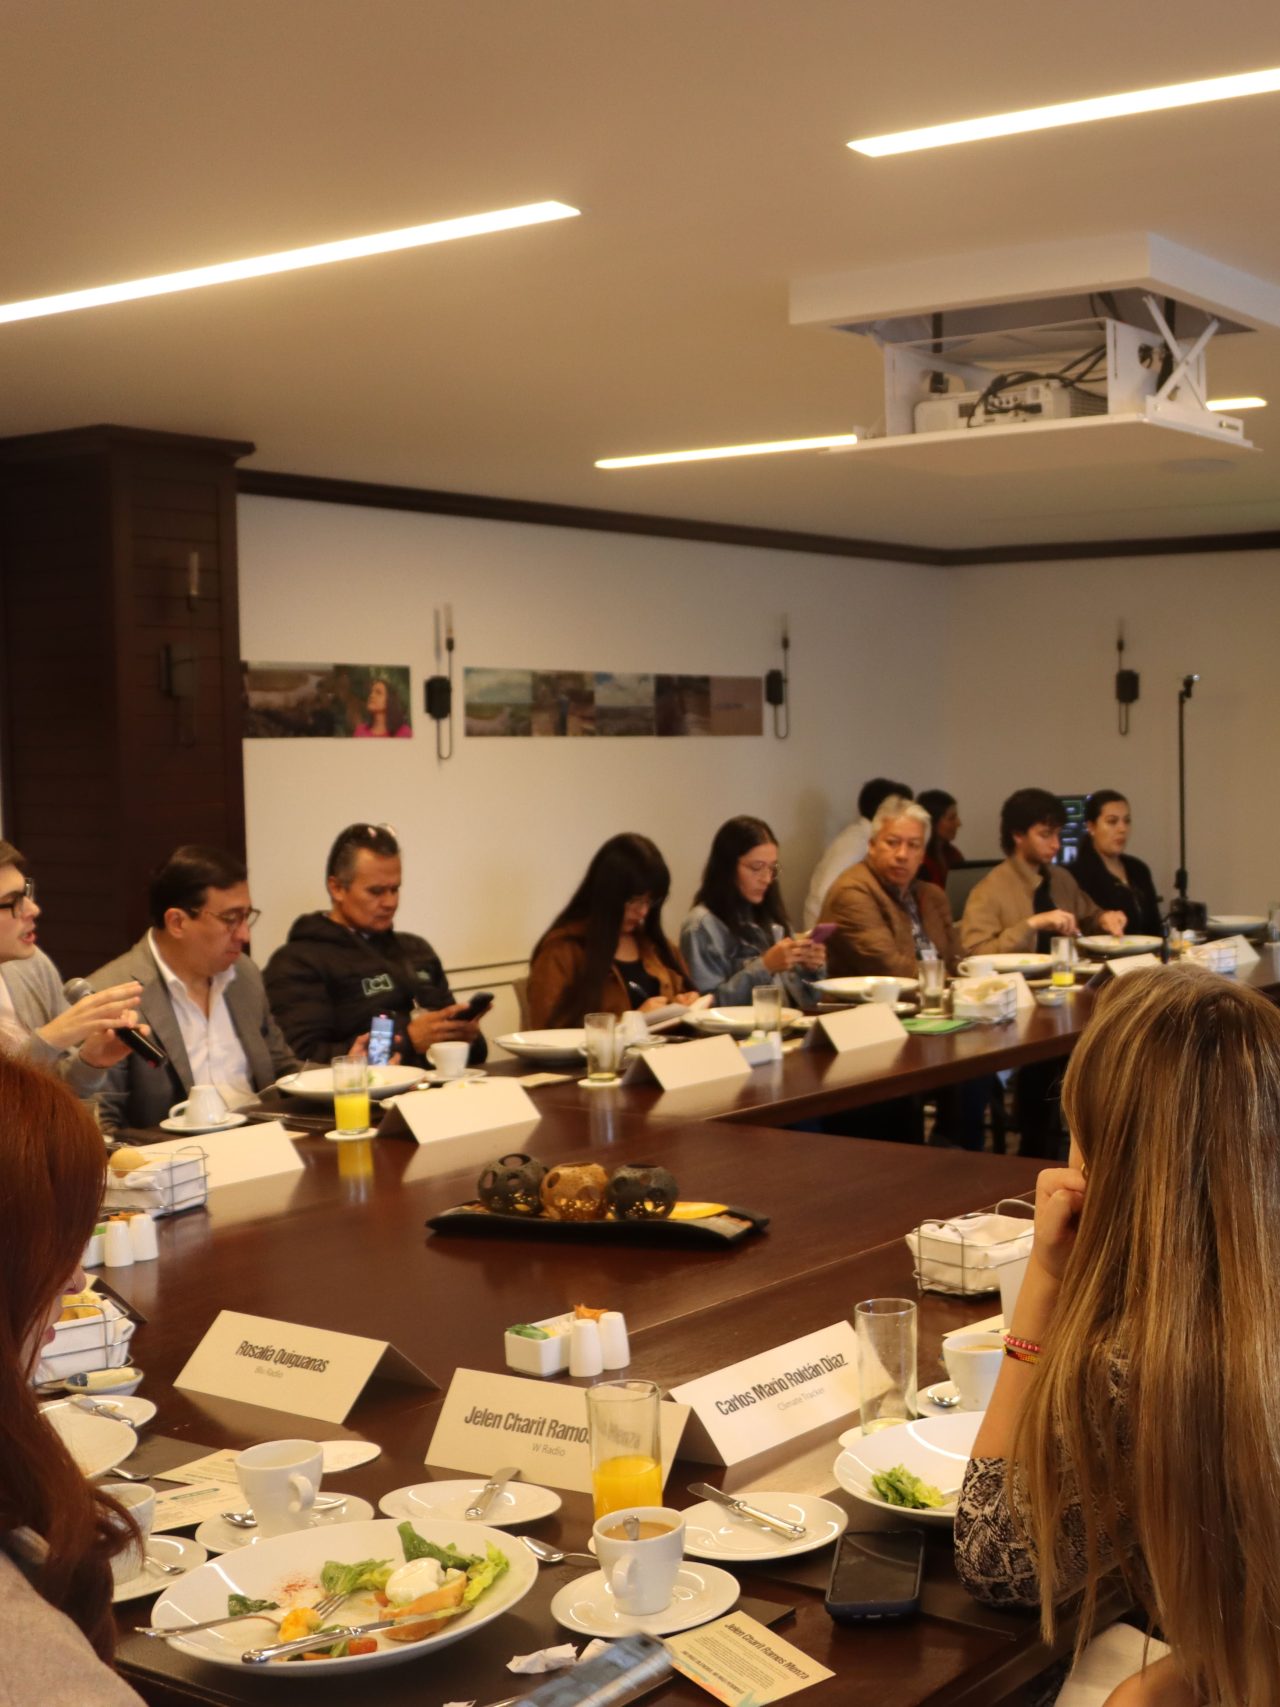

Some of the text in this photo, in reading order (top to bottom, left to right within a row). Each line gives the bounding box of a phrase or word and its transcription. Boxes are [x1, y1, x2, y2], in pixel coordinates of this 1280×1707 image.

[715, 1391, 757, 1416] Carlos
[751, 1377, 789, 1401] Mario
[784, 1362, 826, 1388] Roldán
[464, 1406, 503, 1429] Jelen
[503, 1412, 547, 1437] Charit
[532, 1443, 566, 1457] W Radio
